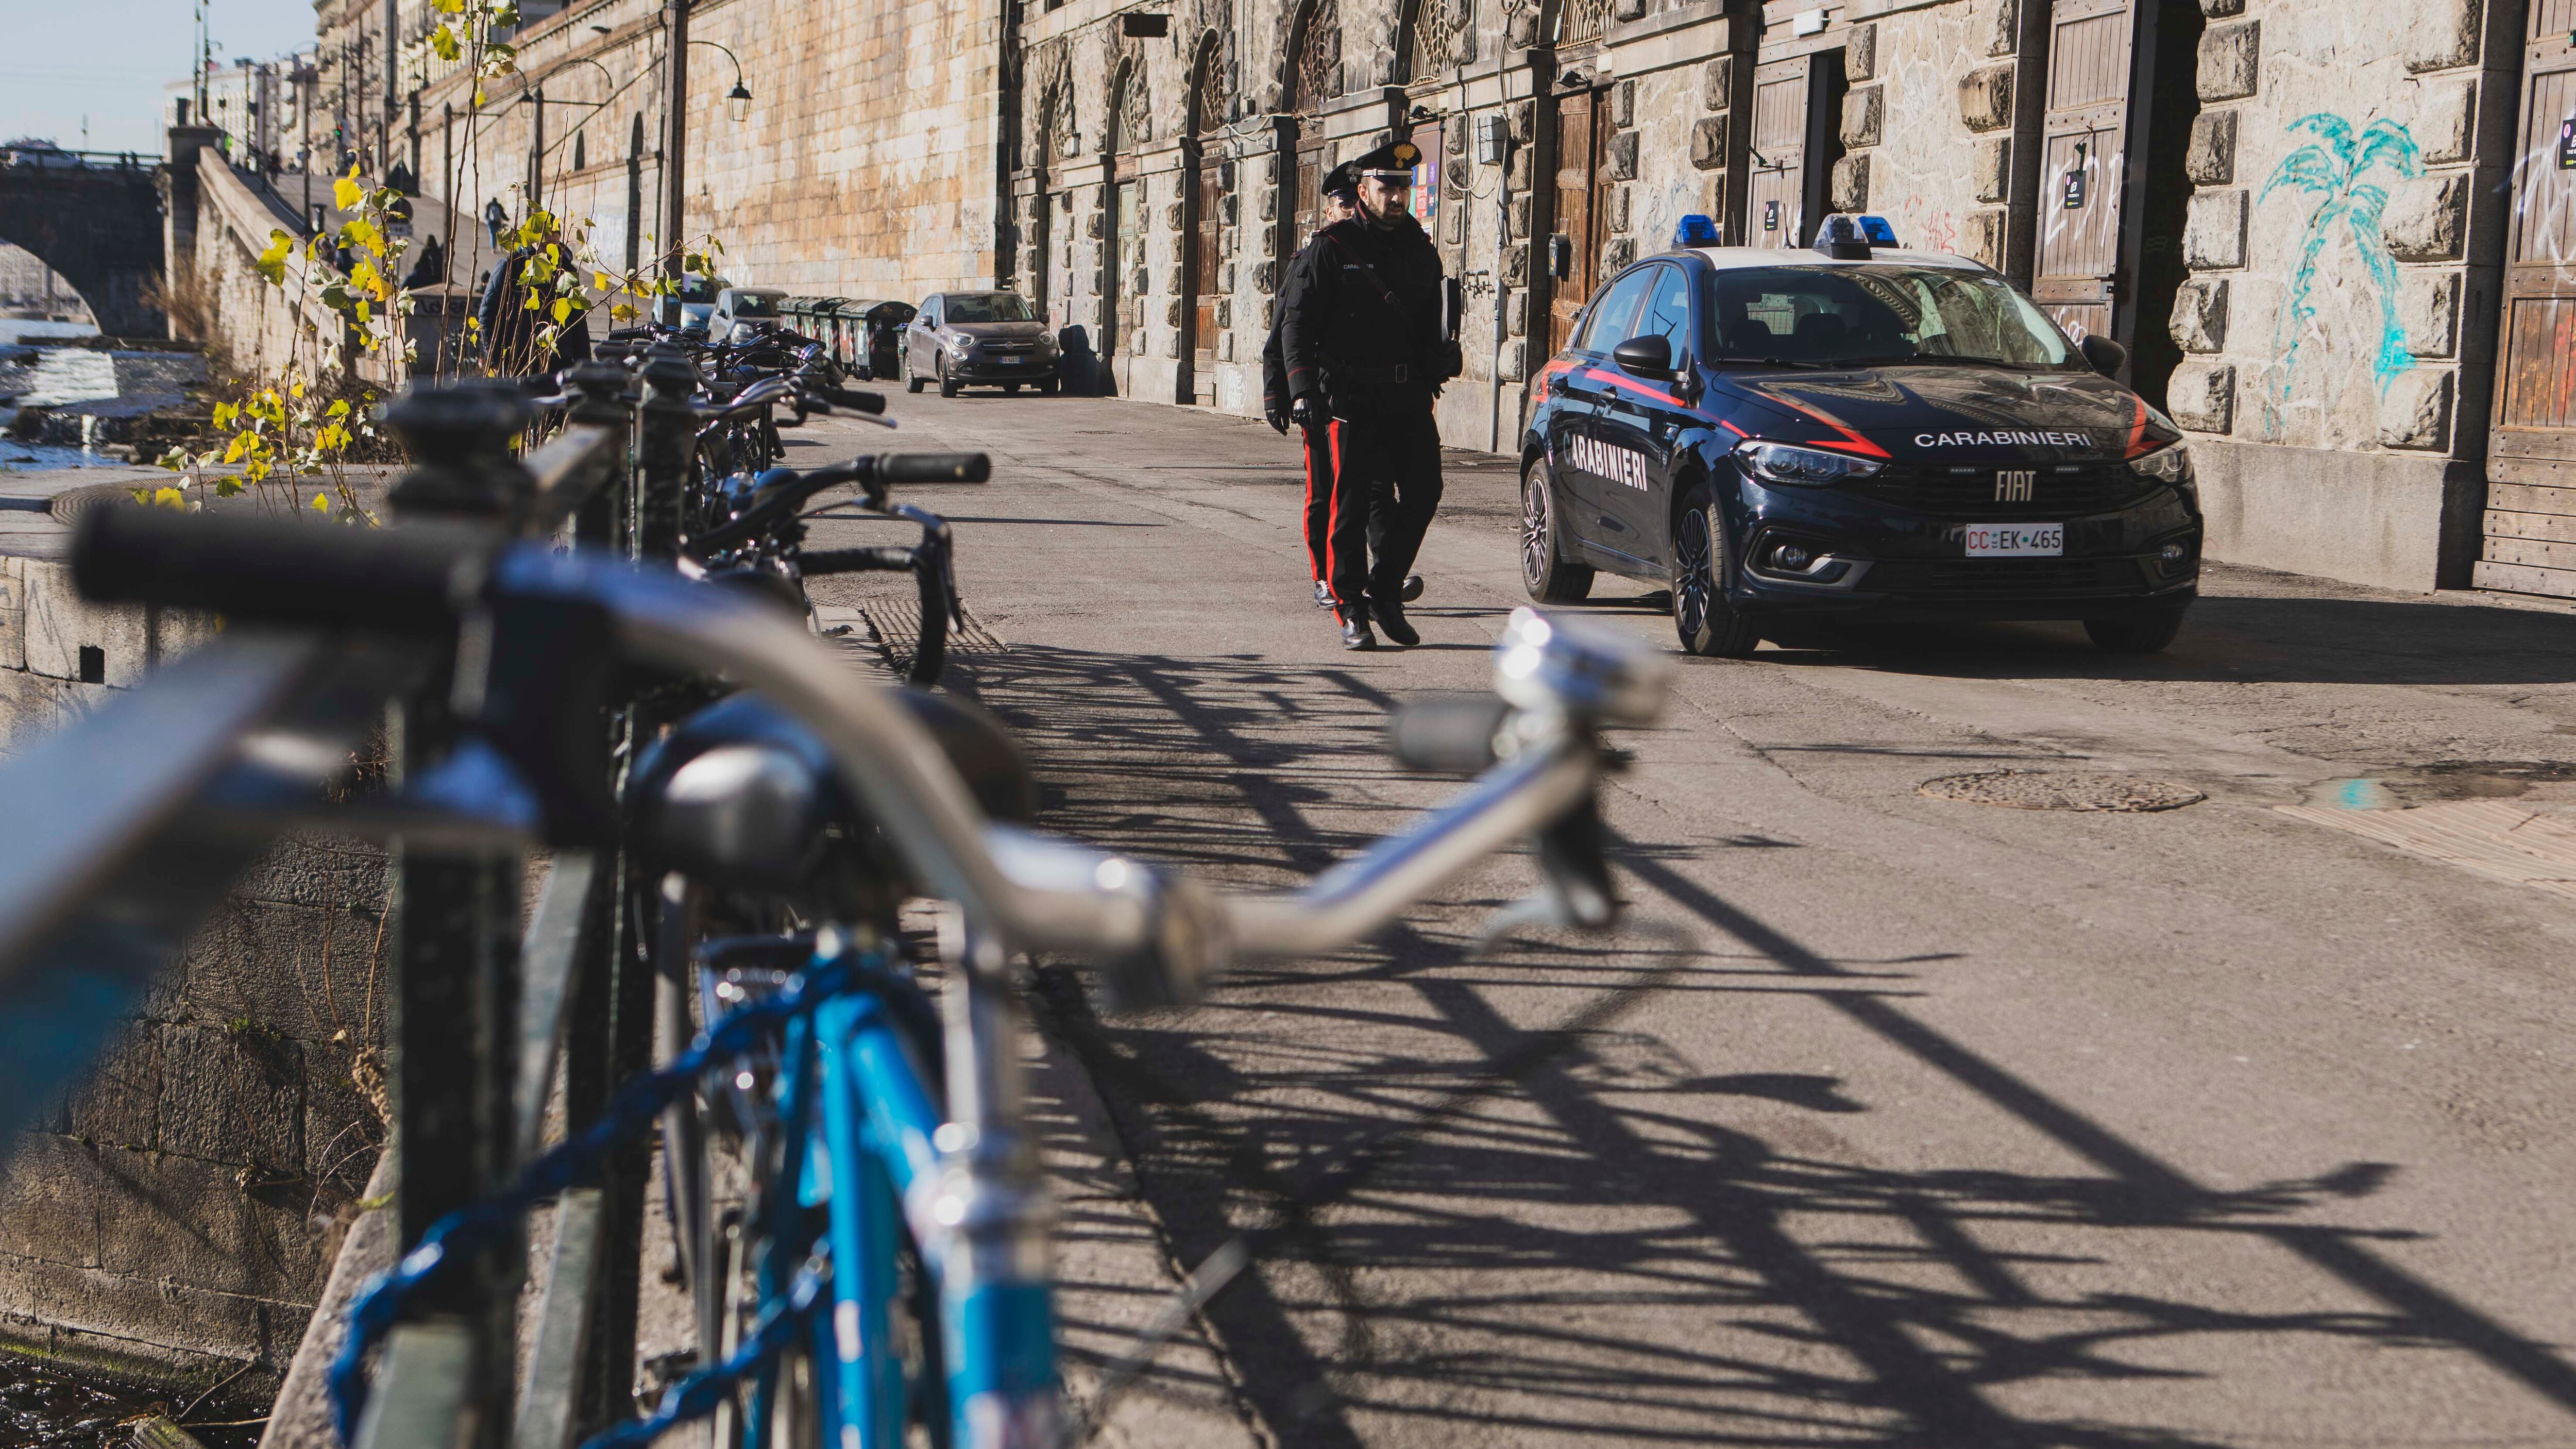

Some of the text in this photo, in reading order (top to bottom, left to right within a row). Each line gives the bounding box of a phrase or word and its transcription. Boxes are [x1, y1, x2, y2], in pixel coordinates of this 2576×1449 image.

[1914, 431, 2092, 447] CARABINIERI
[1563, 430, 1648, 492] CARABINIERI
[1995, 470, 2037, 501] FIAT
[2030, 530, 2061, 549] 465
